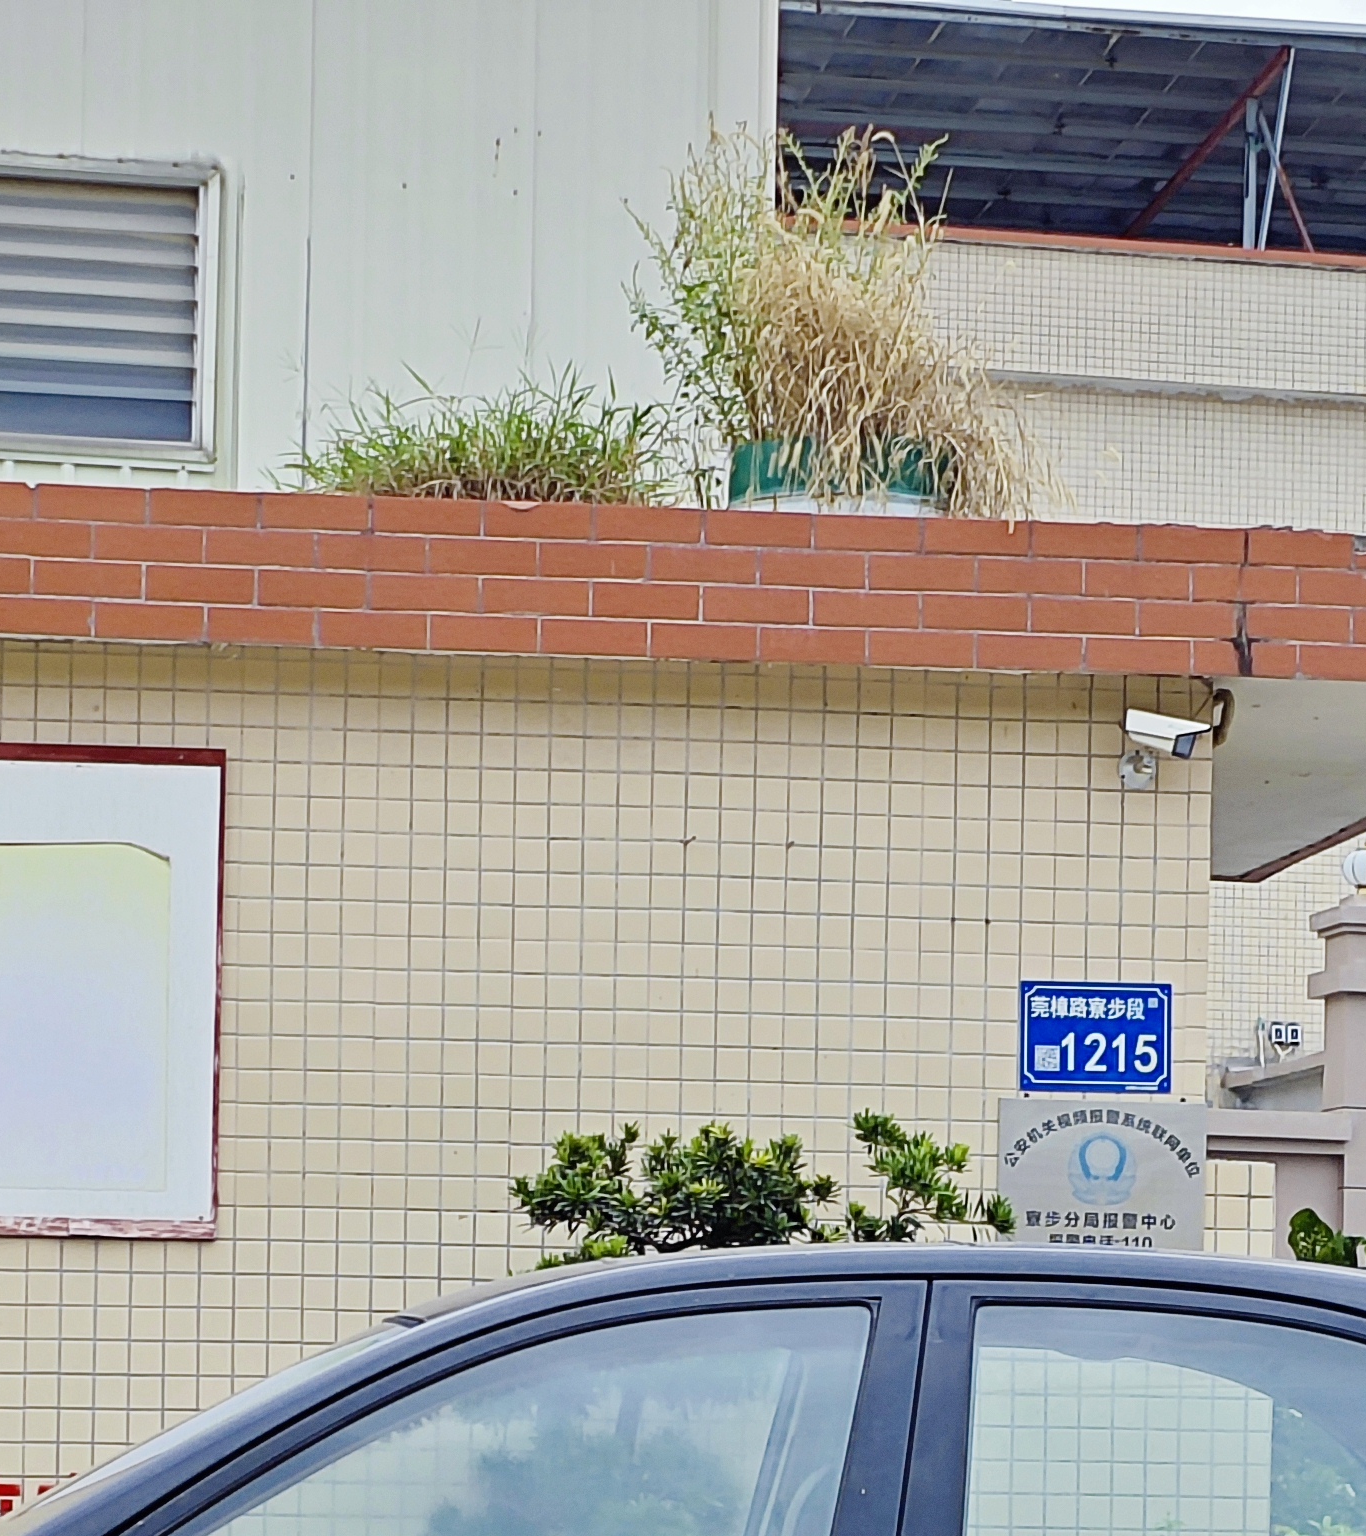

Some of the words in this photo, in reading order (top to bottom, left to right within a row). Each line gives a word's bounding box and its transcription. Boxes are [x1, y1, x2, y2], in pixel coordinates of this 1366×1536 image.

[1029, 995, 1146, 1021] 莞樟路寮步段
[1061, 1031, 1159, 1074] 1215
[1003, 1108, 1201, 1179] 公安机关视频报警系统联网单位
[1025, 1210, 1176, 1231] 寮步分局报警中心
